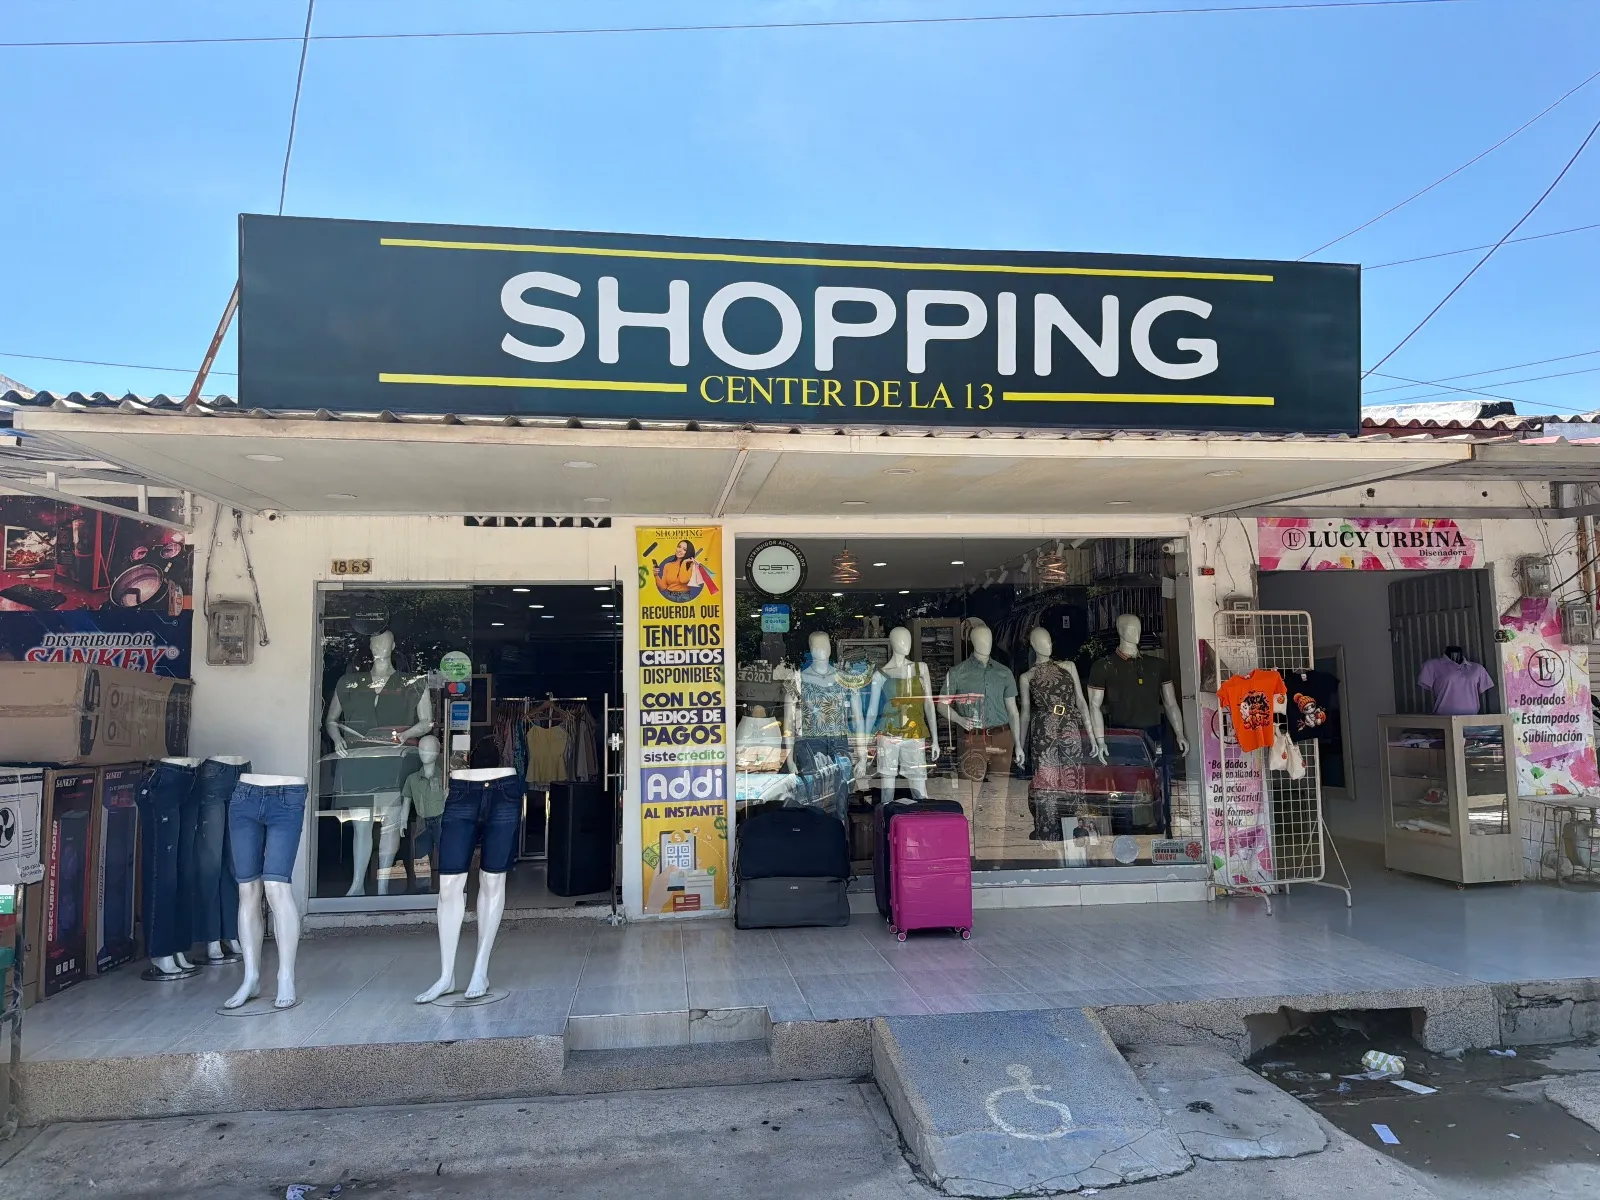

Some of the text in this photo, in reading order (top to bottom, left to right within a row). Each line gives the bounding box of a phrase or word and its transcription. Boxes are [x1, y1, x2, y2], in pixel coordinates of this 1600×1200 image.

[501, 271, 1219, 380] SHOPPING
[699, 375, 994, 410] CENTER DE LA 13
[655, 529, 703, 537] SHOPPING
[1308, 531, 1374, 548] LUCY
[1377, 530, 1466, 548] URBINA
[333, 560, 371, 574] 1869
[642, 604, 720, 620] RECUERDA QUE
[44, 633, 155, 647] DISTRIBUIDOR
[643, 624, 720, 648] TENEMOS
[641, 648, 723, 665] CREDITOS
[643, 666, 721, 685] DISPONIBLES
[642, 691, 722, 708] CON LOS
[1520, 693, 1566, 706] Bordados
[642, 709, 722, 725] MEDIOS DE
[1521, 711, 1580, 727] Estampados
[643, 725, 722, 747] PAGOS
[1522, 730, 1583, 744] Sublimación
[1211, 759, 1248, 770] Bodados
[647, 768, 723, 801] Addi
[1213, 783, 1247, 794] Doación
[644, 804, 724, 819] AL INSTANTE
[1214, 806, 1254, 818] Unformes
[1214, 816, 1243, 827] esolar
[50, 862, 56, 877] EL
[47, 880, 55, 942] DESCUBRE
